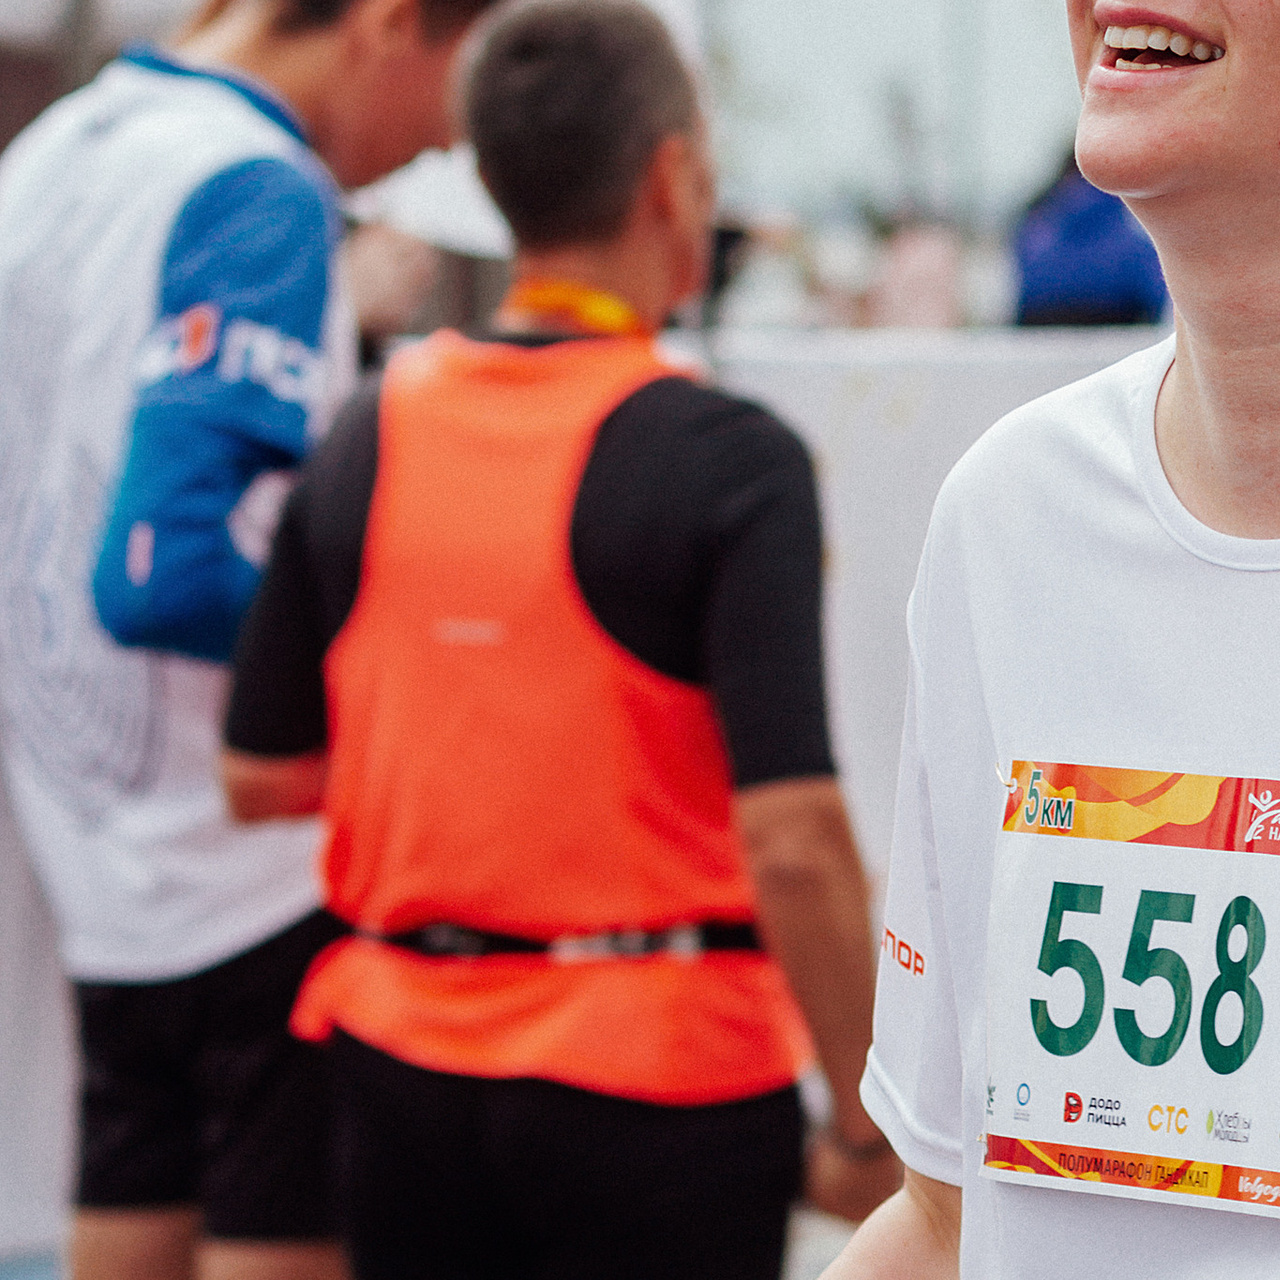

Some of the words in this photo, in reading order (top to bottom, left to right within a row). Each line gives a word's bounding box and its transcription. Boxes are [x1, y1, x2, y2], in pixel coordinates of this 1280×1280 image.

[1024, 770, 1042, 825] 5
[1041, 799, 1074, 829] КМ
[882, 925, 925, 976] ПОР
[1030, 880, 1266, 1075] 558
[1089, 1096, 1121, 1111] ДОДО
[1087, 1112, 1127, 1127] ПИЦЦА
[1147, 1104, 1189, 1134] СТС
[1215, 1109, 1251, 1129] Хлебы
[1058, 1152, 1153, 1181] ПОЛУМАРАФОН
